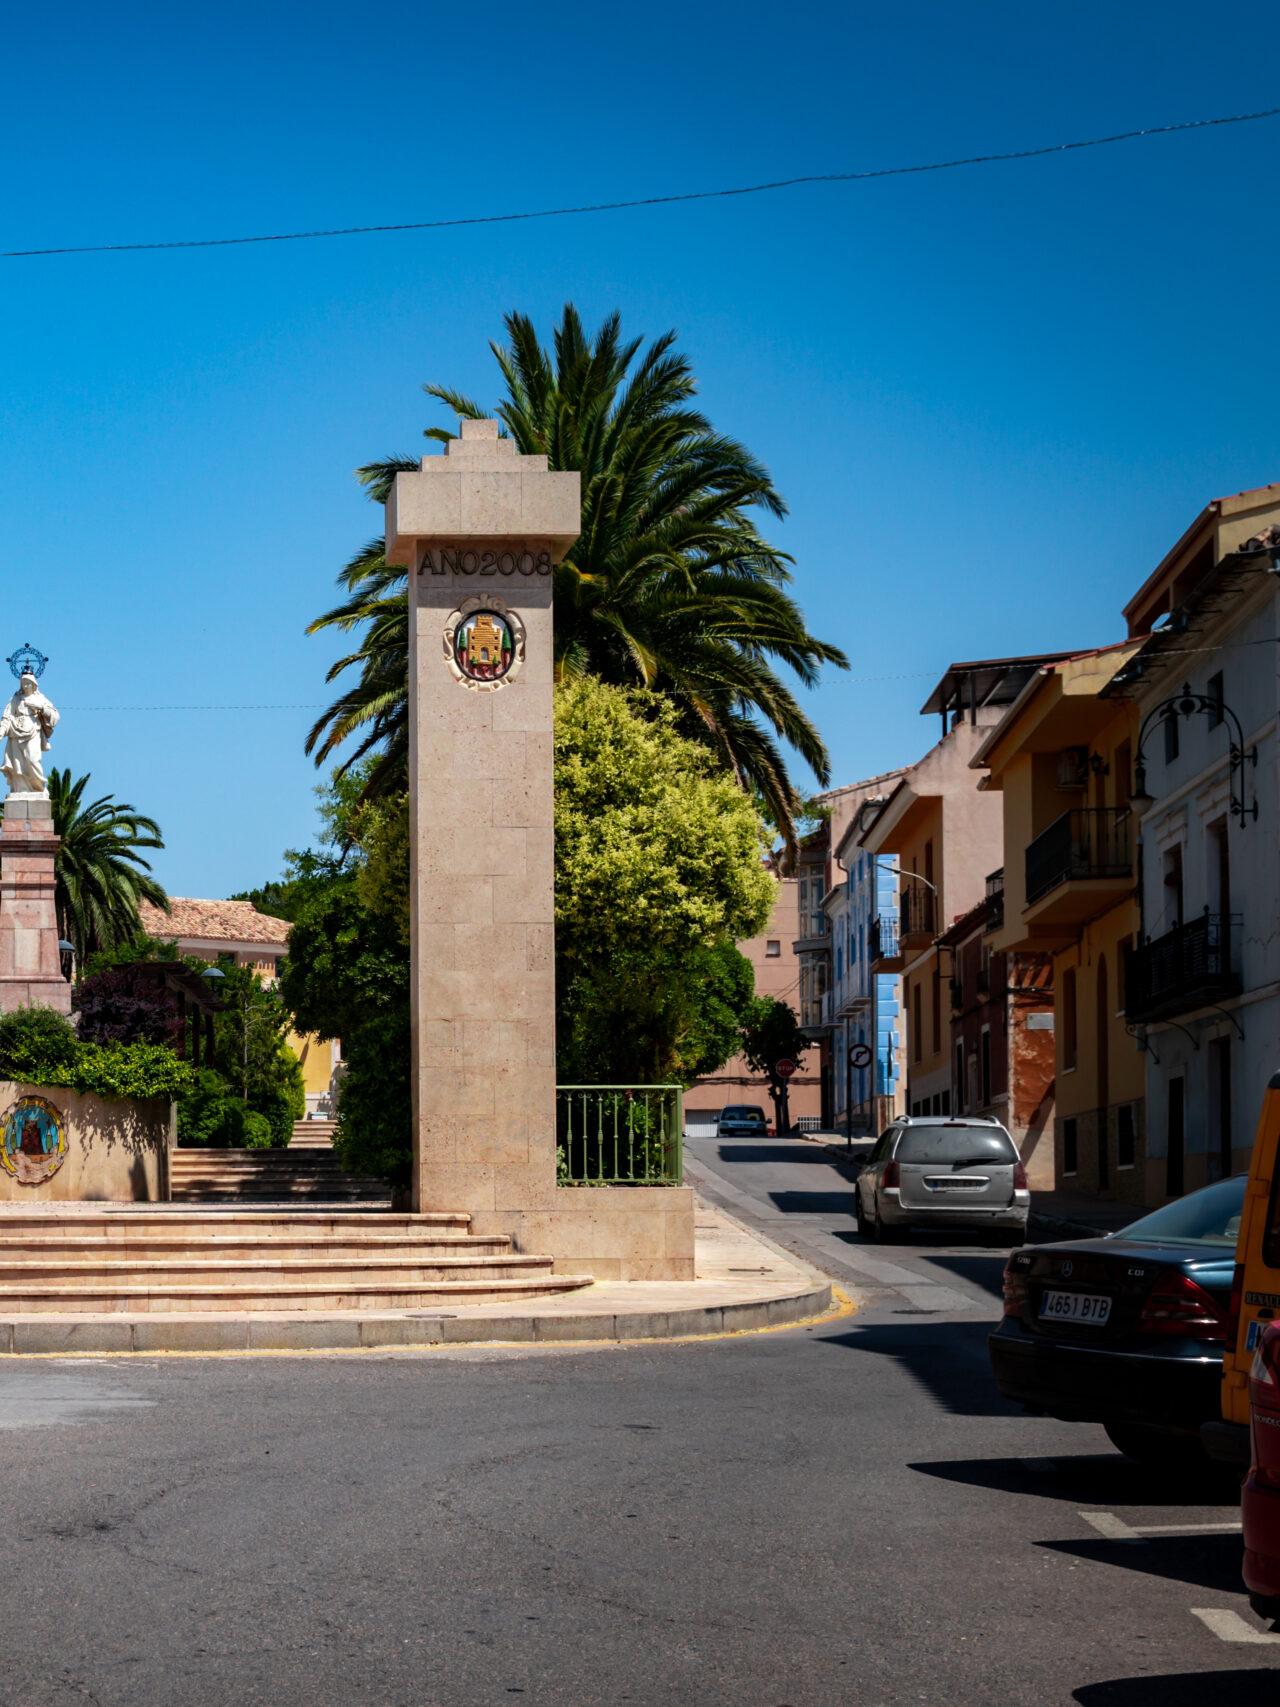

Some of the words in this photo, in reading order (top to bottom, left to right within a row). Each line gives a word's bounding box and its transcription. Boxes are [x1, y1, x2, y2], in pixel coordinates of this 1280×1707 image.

[417, 545, 480, 576] AÑO
[480, 550, 552, 576] 2008
[1128, 1268, 1144, 1277] CDI
[1048, 1294, 1078, 1316] 4651
[1081, 1297, 1109, 1318] BTB
